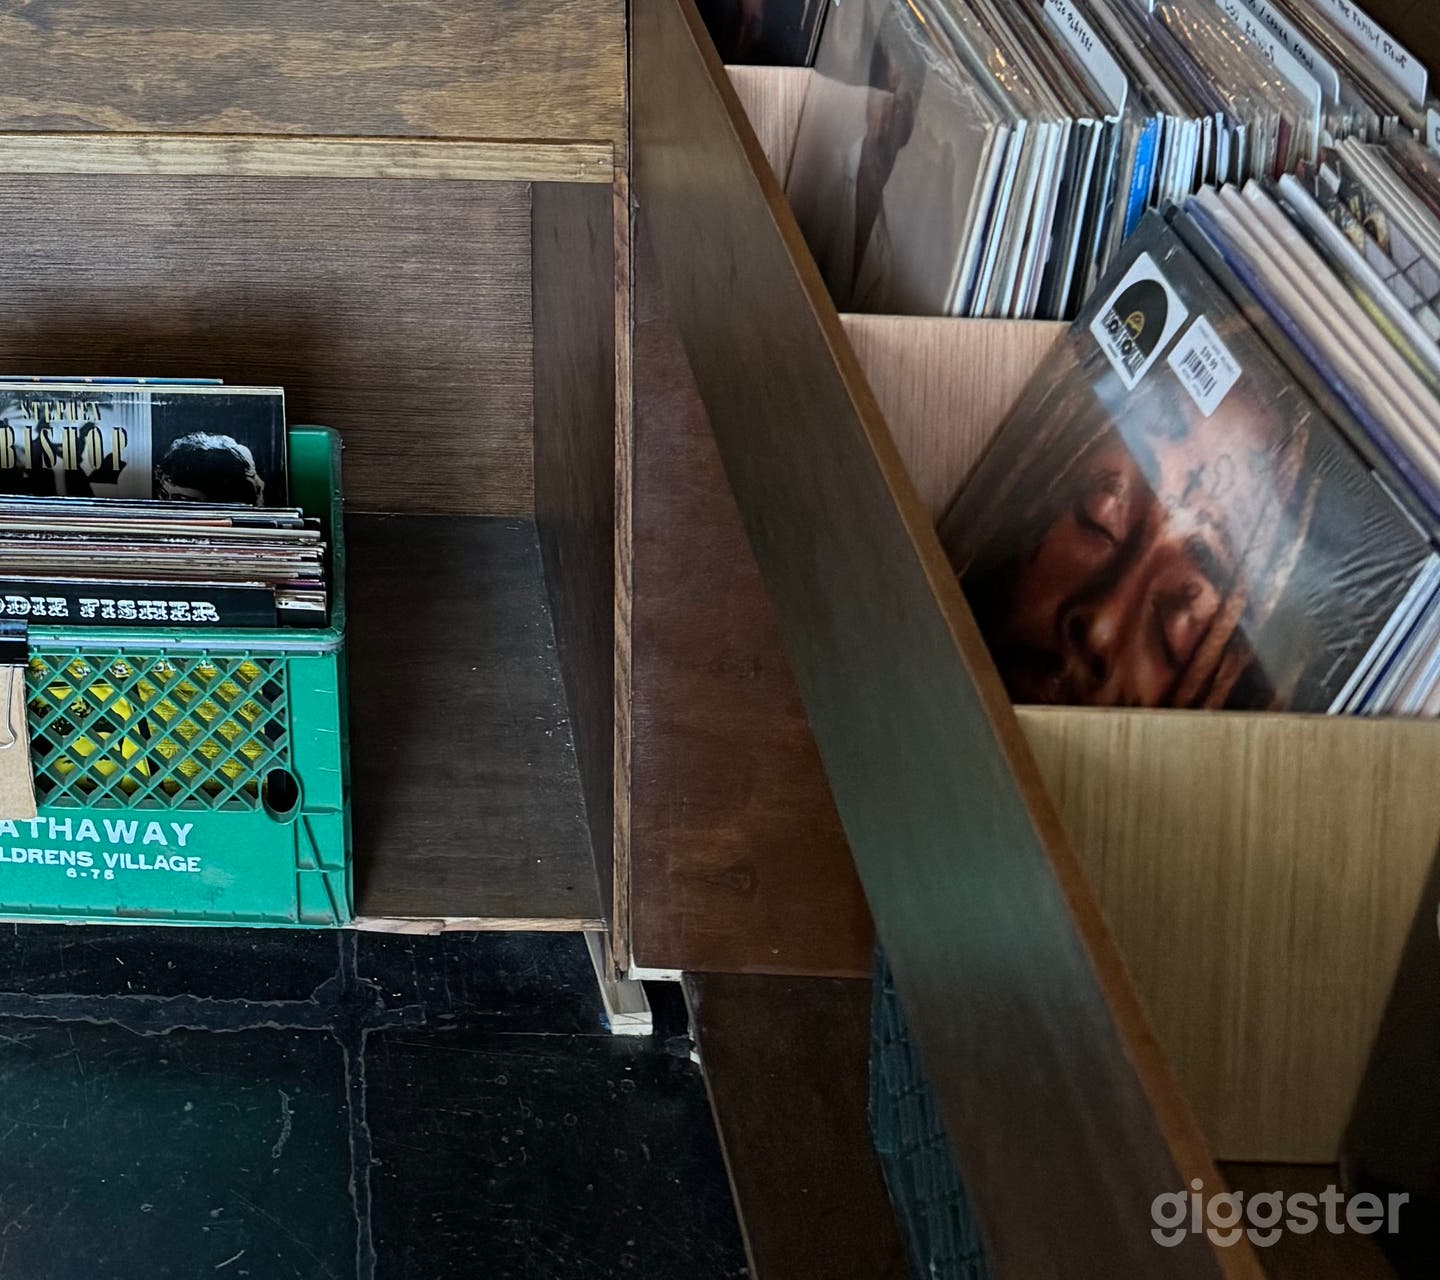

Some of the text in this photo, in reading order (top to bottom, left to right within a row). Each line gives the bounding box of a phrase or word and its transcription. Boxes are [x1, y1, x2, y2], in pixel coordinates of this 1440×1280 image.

[20, 399, 102, 421] STEPHEN
[79, 595, 220, 623] FISHER
[101, 851, 202, 873] VILLAGE
